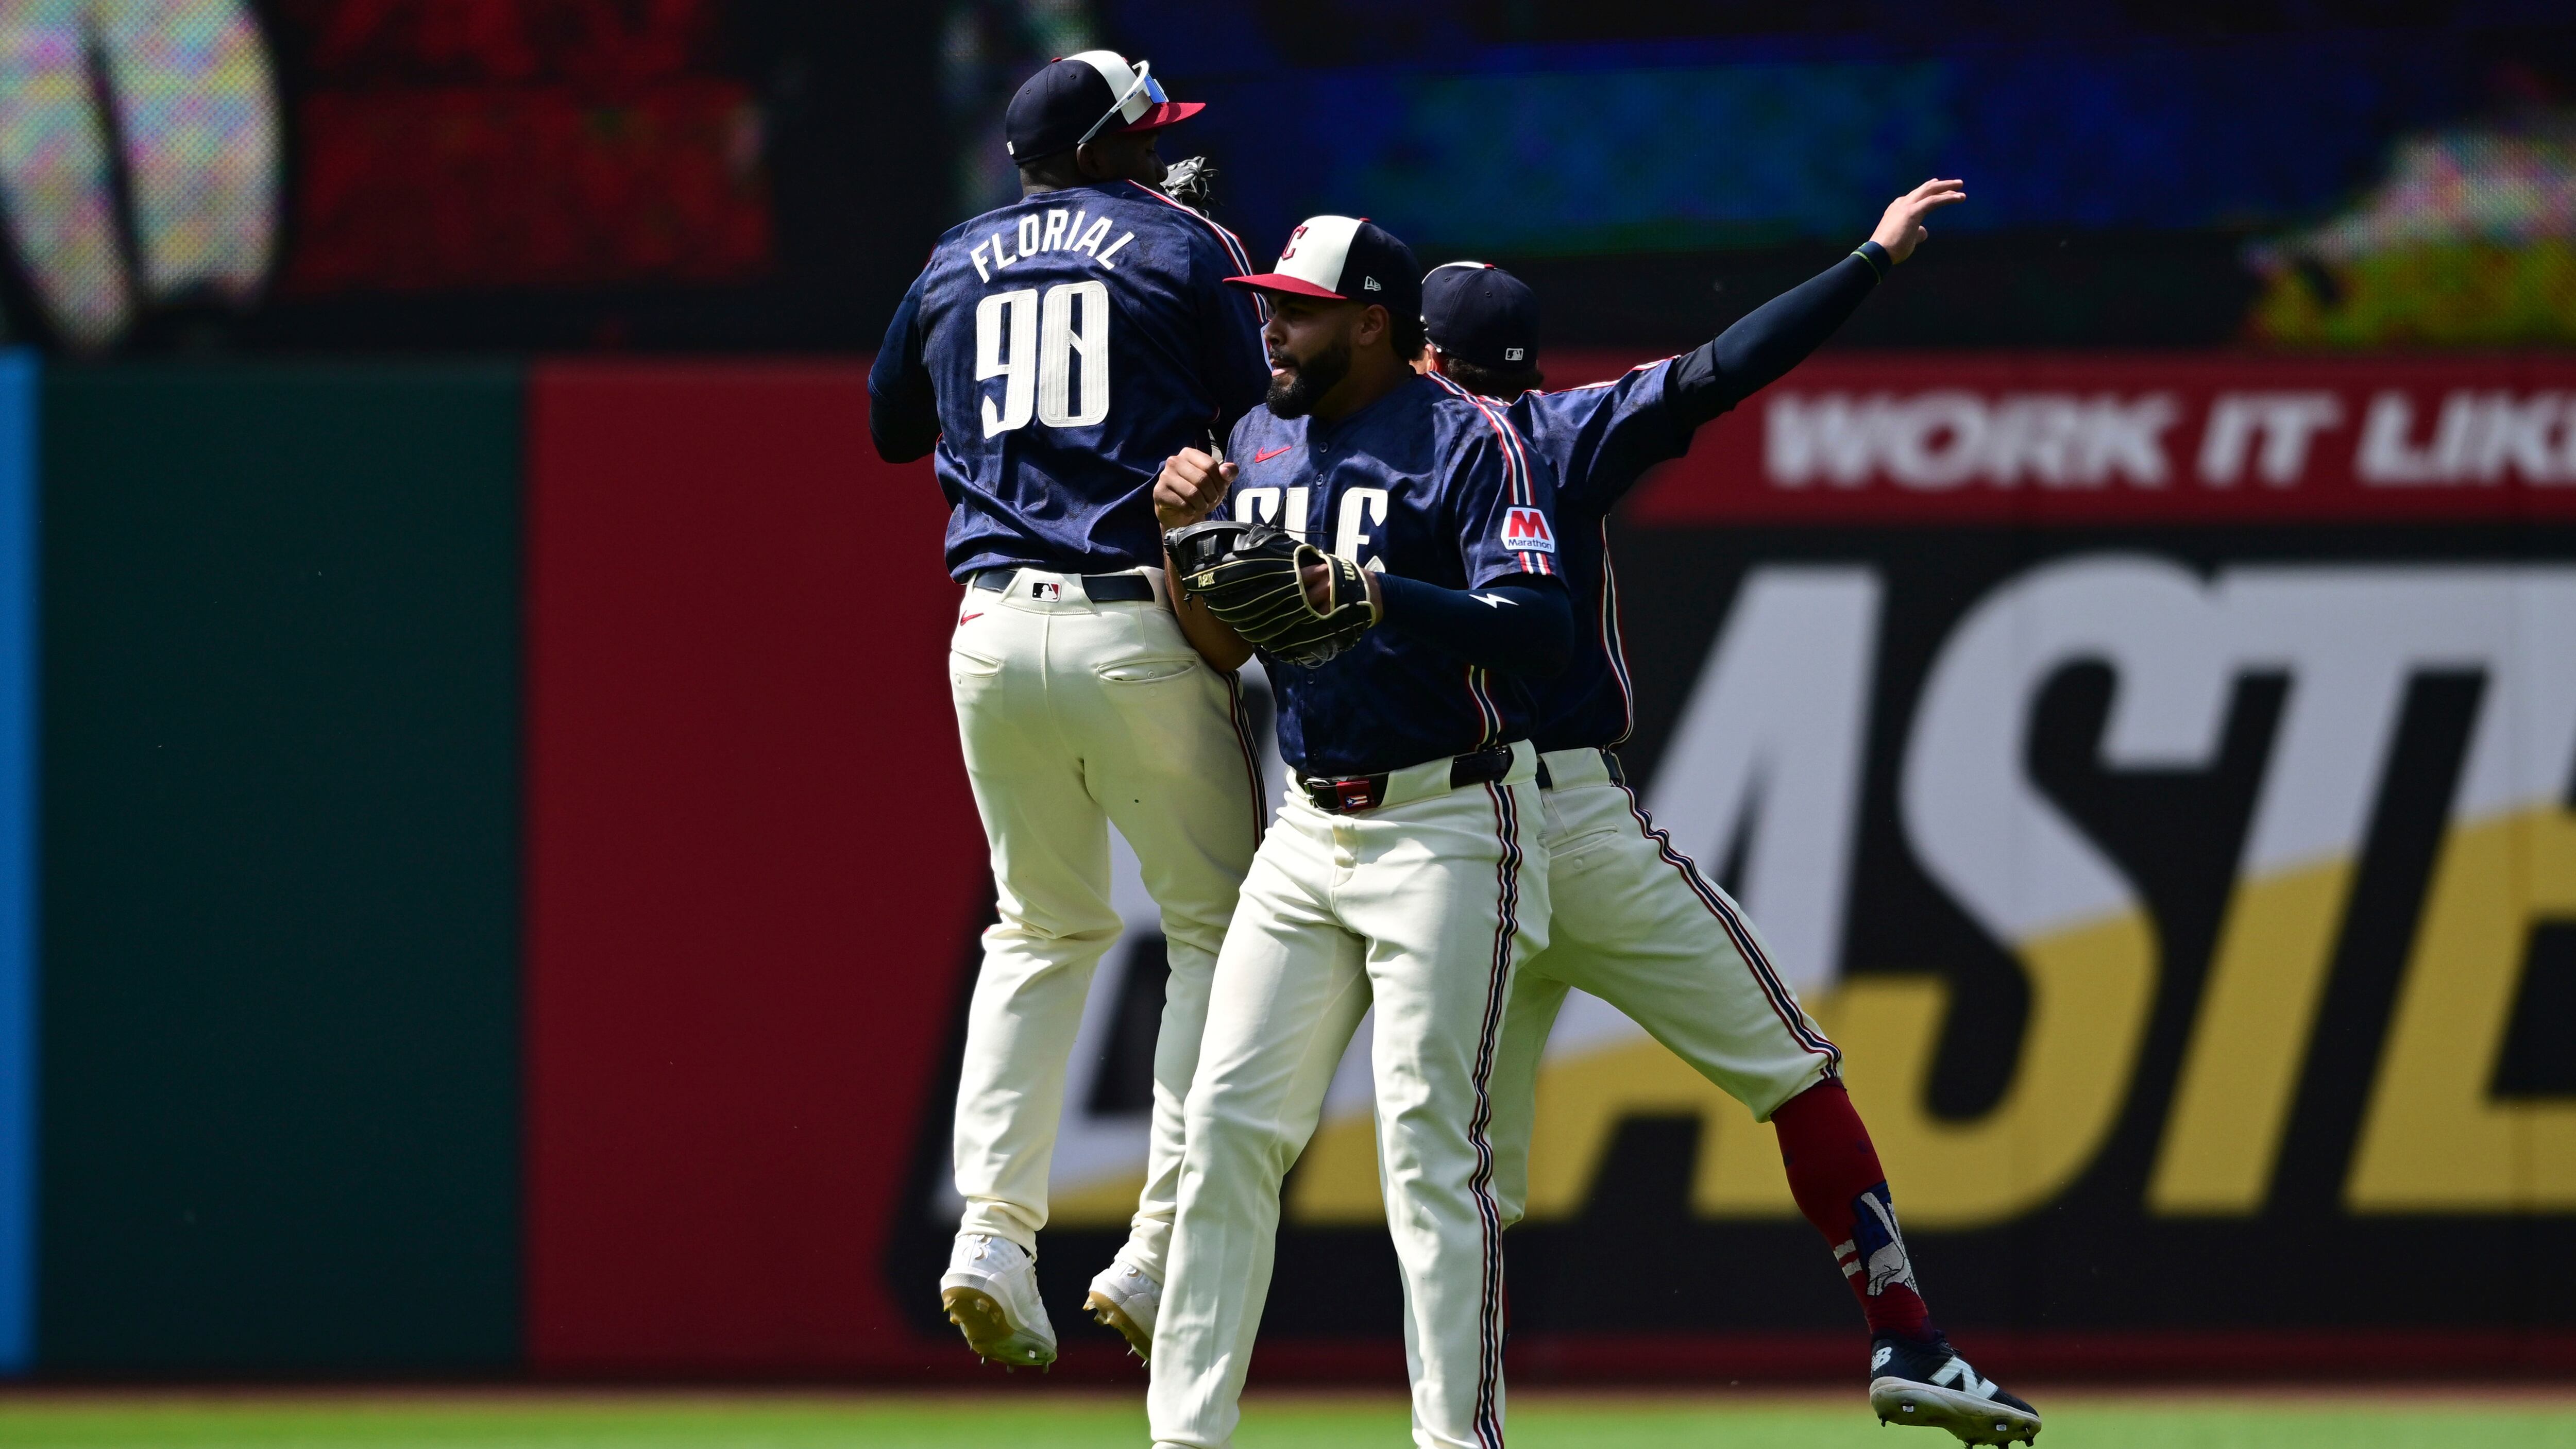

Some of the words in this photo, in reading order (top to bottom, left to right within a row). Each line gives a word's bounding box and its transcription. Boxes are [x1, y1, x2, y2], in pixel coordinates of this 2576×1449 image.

[970, 209, 1135, 283] FLORIAL
[1281, 225, 1309, 261] C
[976, 280, 1109, 439] 90
[1767, 393, 2173, 487] WORK
[2200, 393, 2339, 487] IT
[2353, 391, 2576, 487] LIK
[1508, 510, 1550, 541] M
[1508, 539, 1552, 550] Marathon
[1198, 571, 1216, 588] A2K
